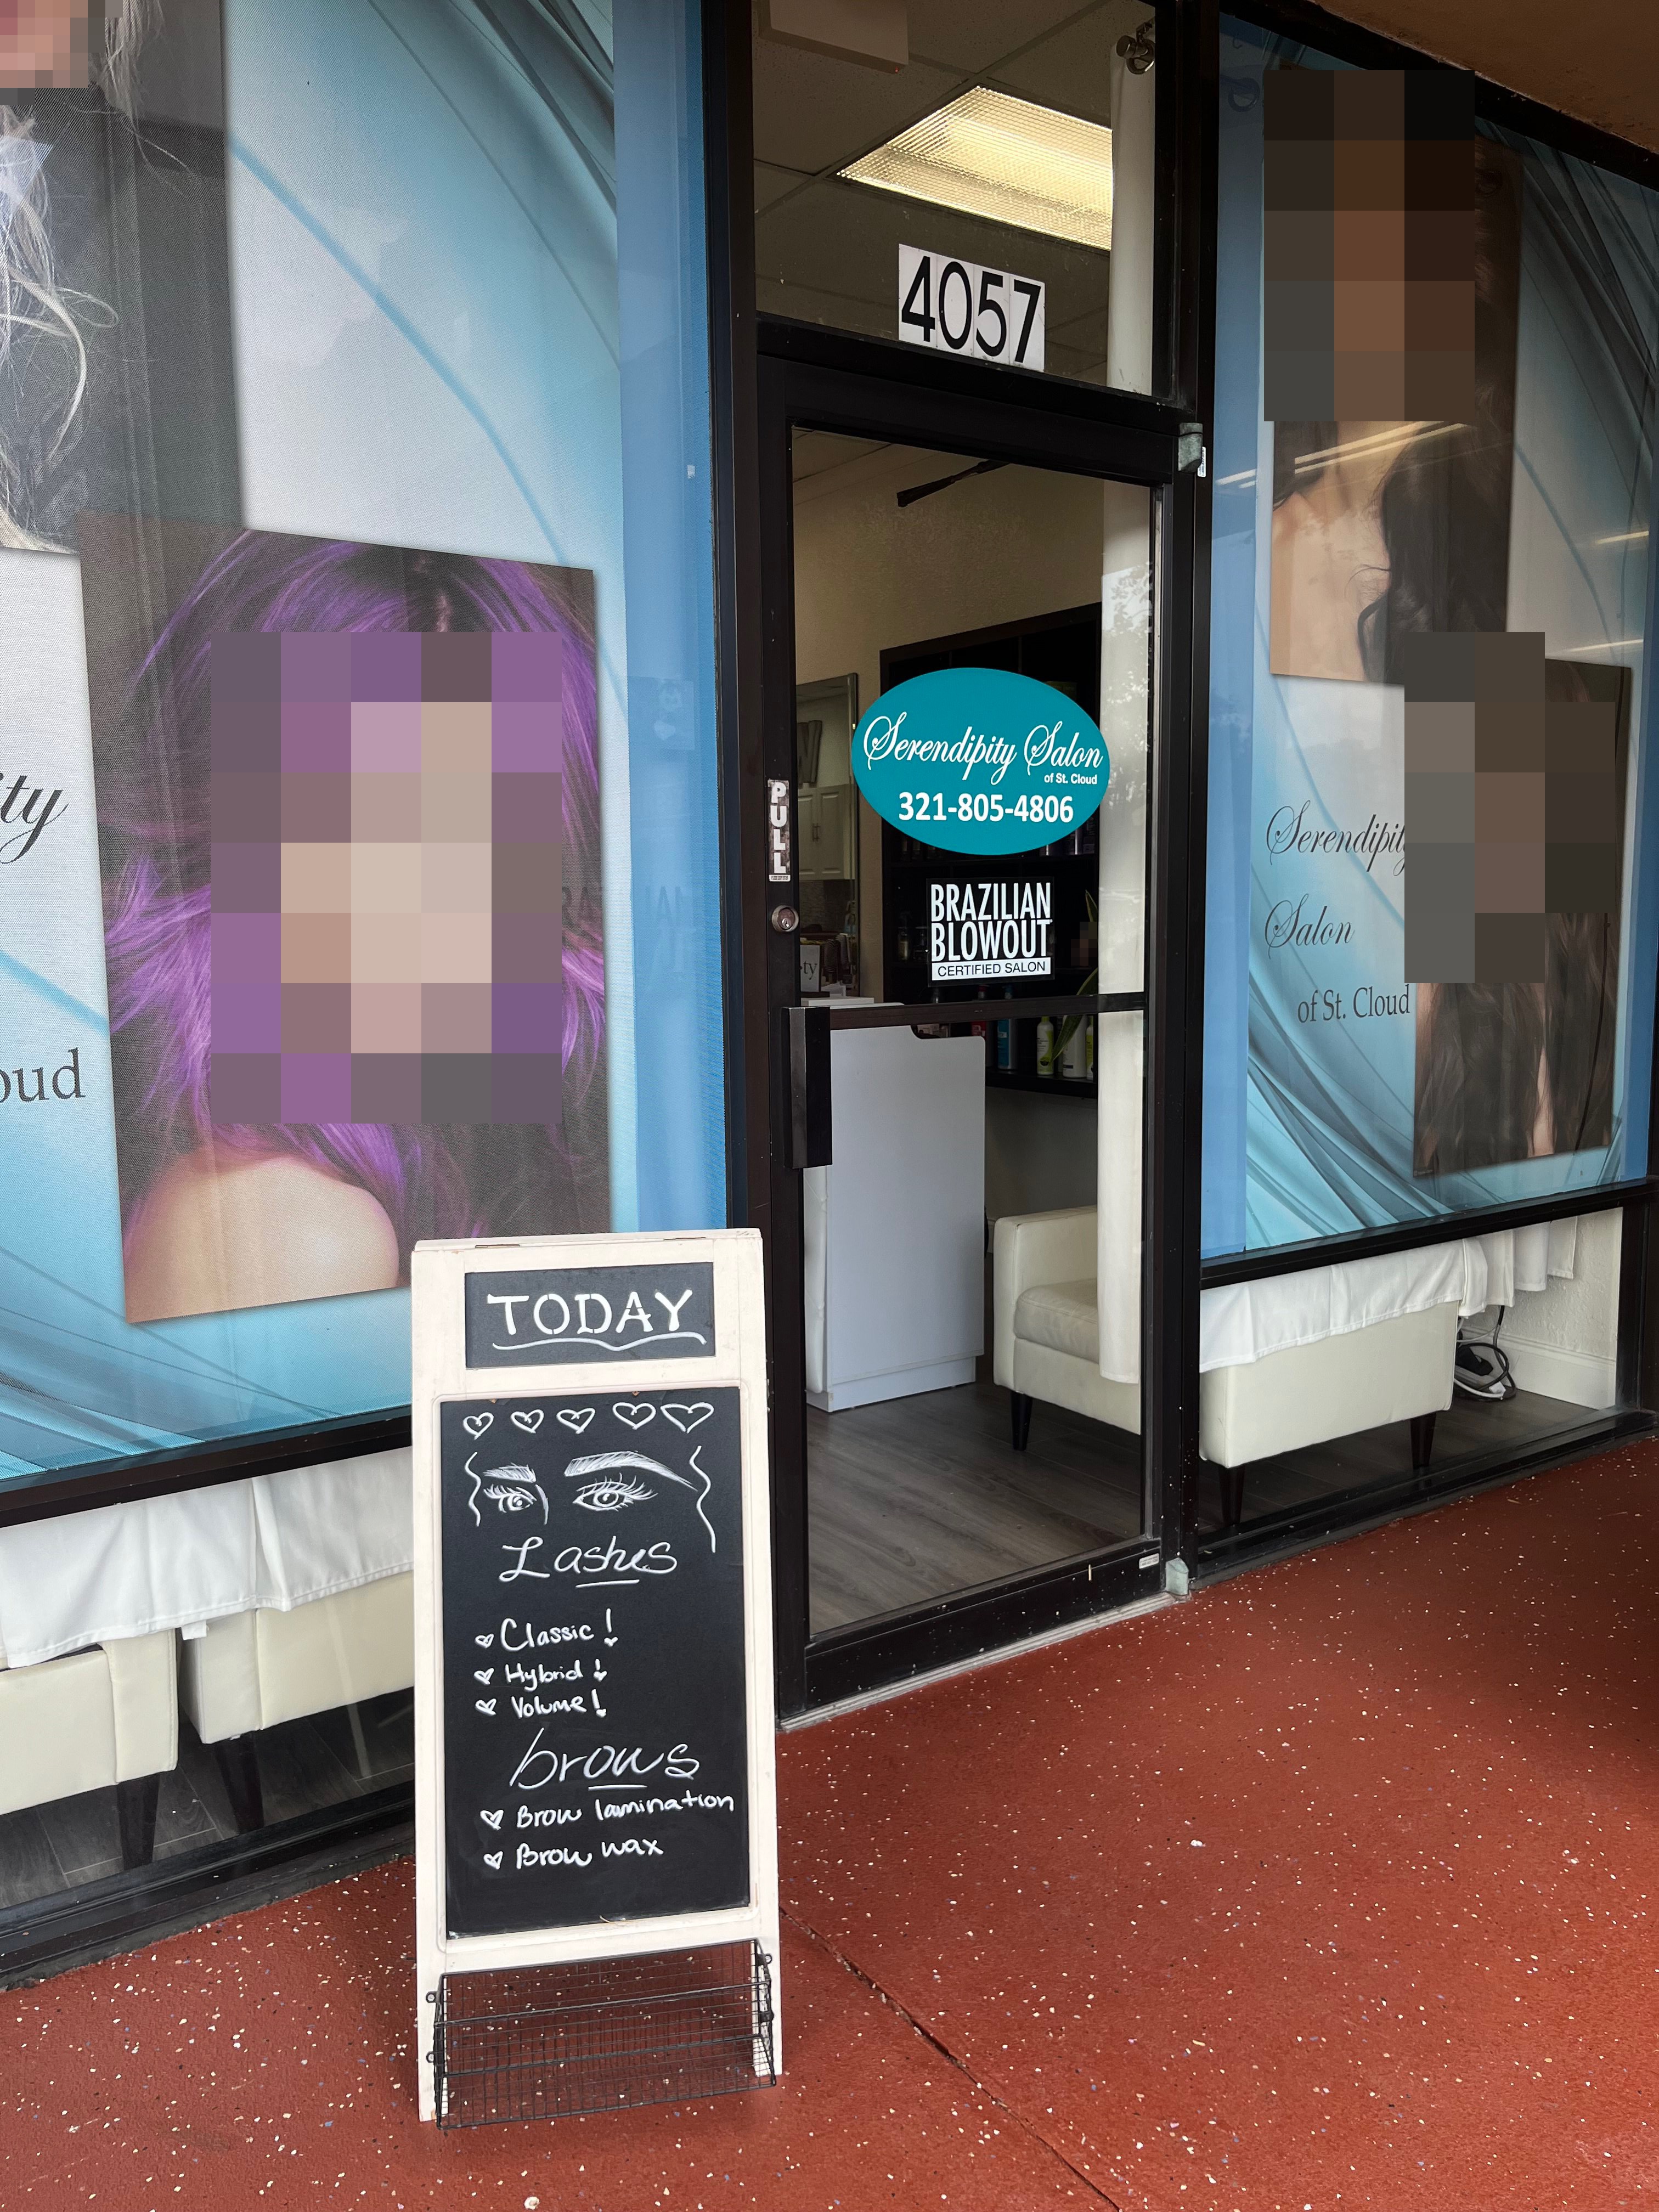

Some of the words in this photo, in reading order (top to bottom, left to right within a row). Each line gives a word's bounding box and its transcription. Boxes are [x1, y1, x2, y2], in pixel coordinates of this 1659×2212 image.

[901, 256, 1041, 363] 4057
[863, 712, 1017, 785] Serendipity
[1024, 721, 1103, 776] Salon
[1044, 772, 1054, 783] of
[1056, 772, 1068, 783] St.
[1070, 773, 1097, 785] Cloud
[0, 772, 69, 864] ty
[770, 782, 787, 874] PULL
[899, 792, 1074, 823] 321-805-4806
[931, 882, 1051, 922] BRAZILIAN
[931, 919, 1051, 962] BLOWOUT
[1265, 893, 1355, 960] Salon
[800, 961, 817, 980] ty
[938, 963, 1001, 977] CERTIFIED
[1005, 961, 1045, 973] SALON
[1297, 990, 1318, 1023] of
[1323, 989, 1346, 1021] St.
[1353, 984, 1410, 1018] Cloud
[487, 1289, 693, 1335] TODAY
[499, 1536, 678, 1582] Lashes
[509, 1727, 701, 1790] brows
[516, 1805, 582, 1829] Brow
[595, 1790, 735, 1821] lamination
[517, 1843, 592, 1870] Brow
[601, 1838, 664, 1857] wax
